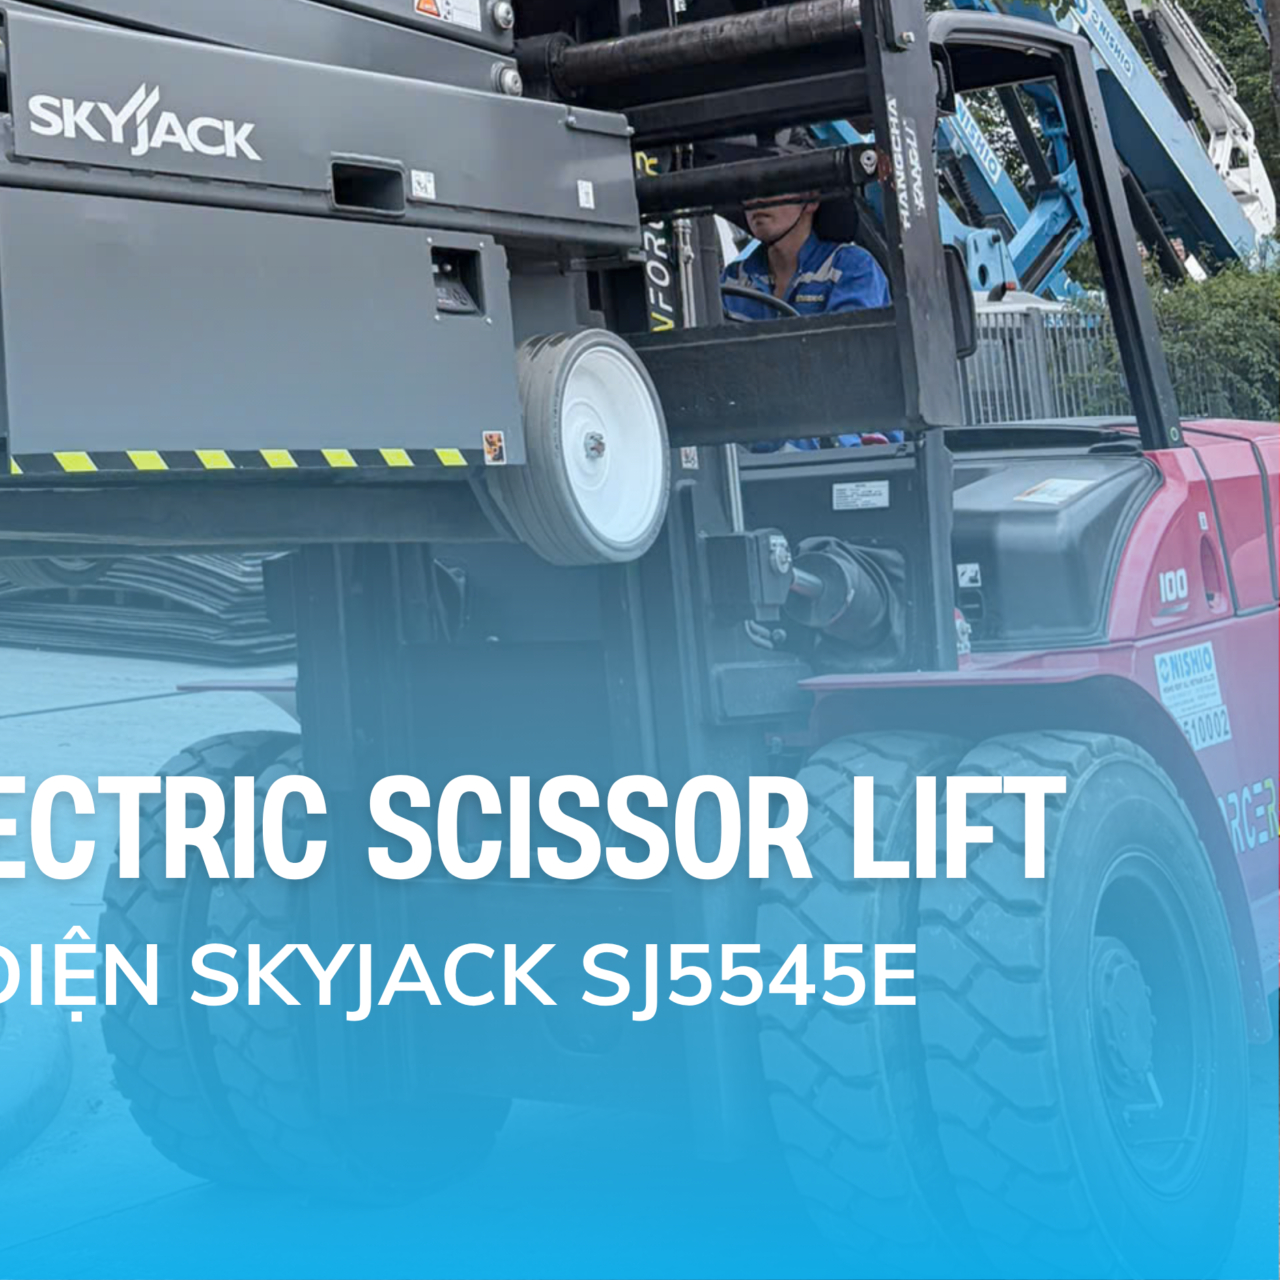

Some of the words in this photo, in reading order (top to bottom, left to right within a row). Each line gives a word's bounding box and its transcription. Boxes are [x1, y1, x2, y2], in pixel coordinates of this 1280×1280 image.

[28, 82, 262, 161] SKYJACK
[886, 98, 911, 231] HANGCHA
[1158, 568, 1189, 604] 100
